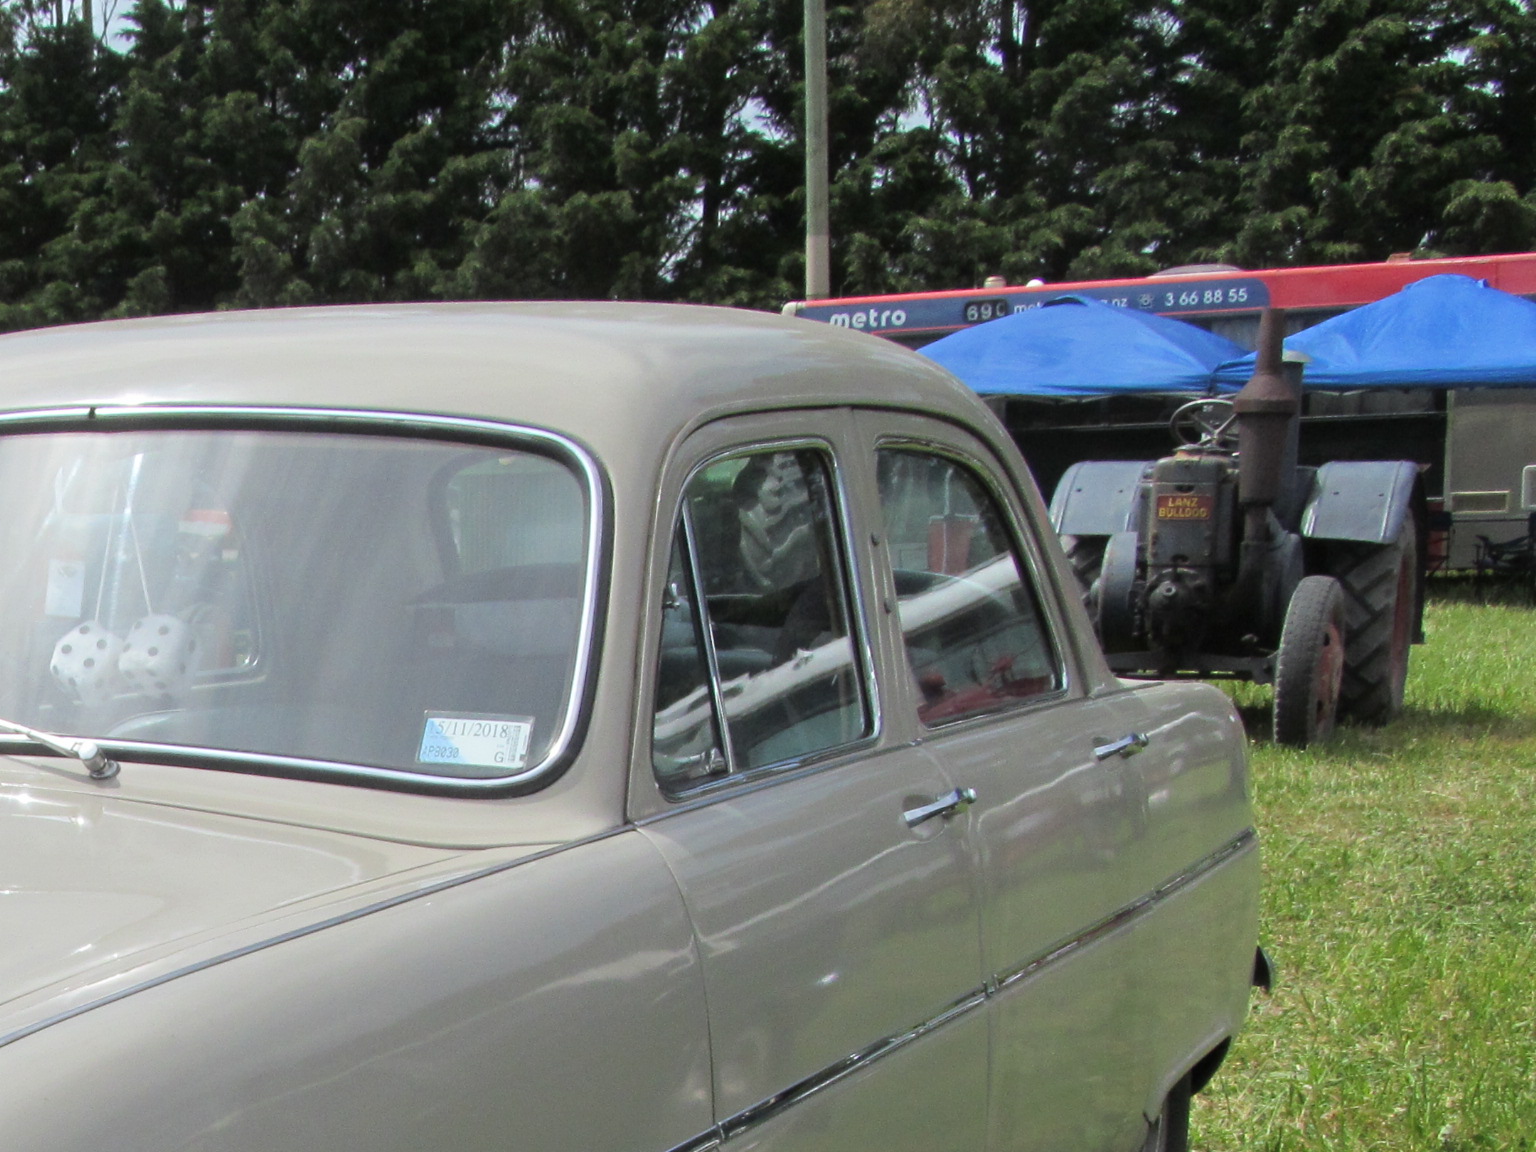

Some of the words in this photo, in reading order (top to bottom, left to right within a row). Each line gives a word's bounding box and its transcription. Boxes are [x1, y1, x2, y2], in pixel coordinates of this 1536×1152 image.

[1165, 292, 1175, 306] 3
[1179, 291, 1199, 305] 66
[1203, 289, 1223, 304] 88
[1228, 287, 1248, 302] 55
[830, 308, 907, 328] metro
[1168, 497, 1199, 507] LANZ
[1158, 507, 1208, 518] BULLDOG
